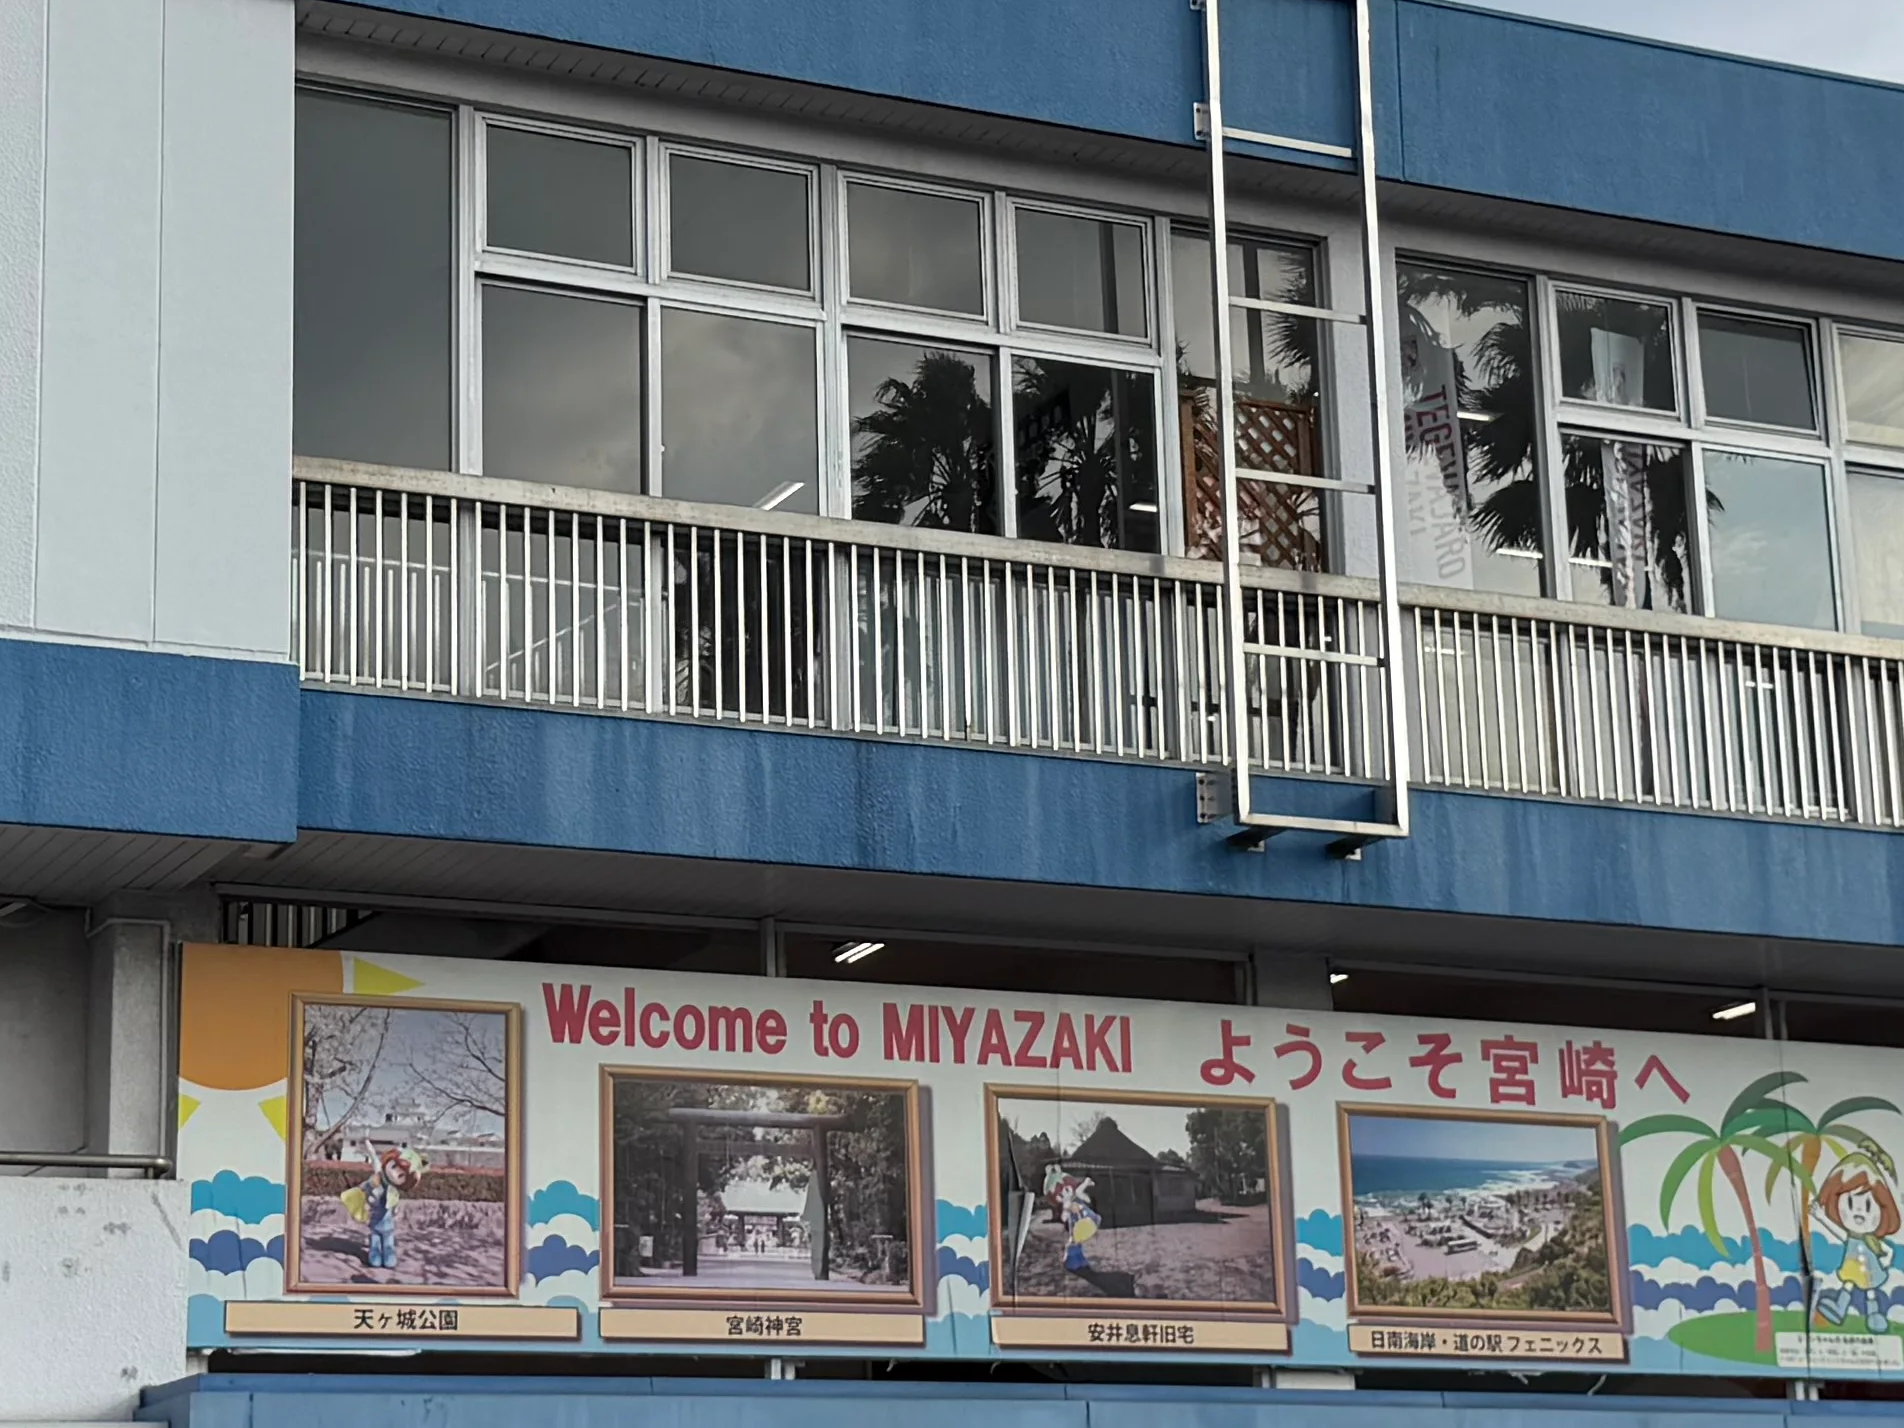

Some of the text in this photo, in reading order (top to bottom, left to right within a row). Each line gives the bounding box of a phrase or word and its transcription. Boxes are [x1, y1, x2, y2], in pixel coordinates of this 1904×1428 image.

[542, 982, 1133, 1073] Welcome to MIYAZAKI
[1200, 1019, 1690, 1110] ようこそ宮崎へ
[352, 1308, 459, 1332] 天ヶ城公園
[725, 1315, 803, 1338] 宮崎神宮
[1087, 1322, 1194, 1346] 安井息軒旧宅
